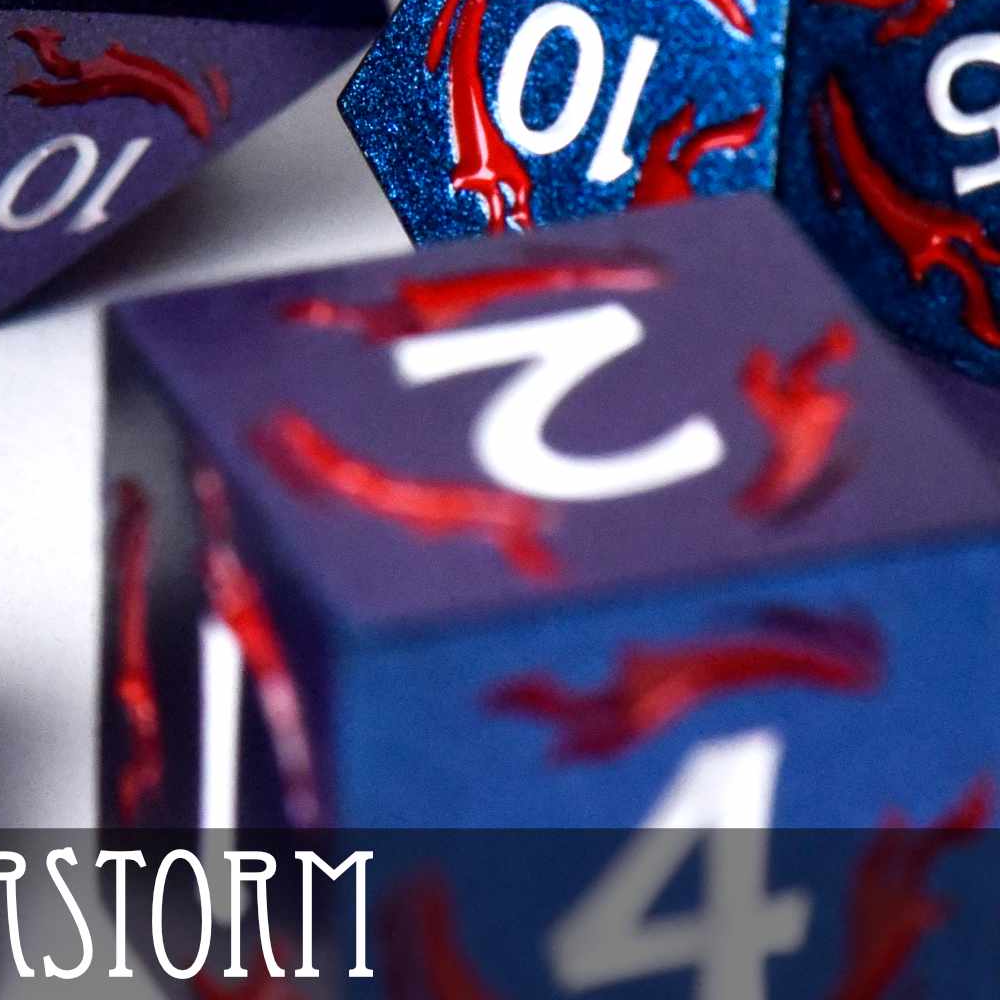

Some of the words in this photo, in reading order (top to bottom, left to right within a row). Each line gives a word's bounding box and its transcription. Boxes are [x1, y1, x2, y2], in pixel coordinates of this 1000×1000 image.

[497, 1, 660, 184] 10
[392, 301, 727, 501] 2
[549, 727, 813, 1000] 4
